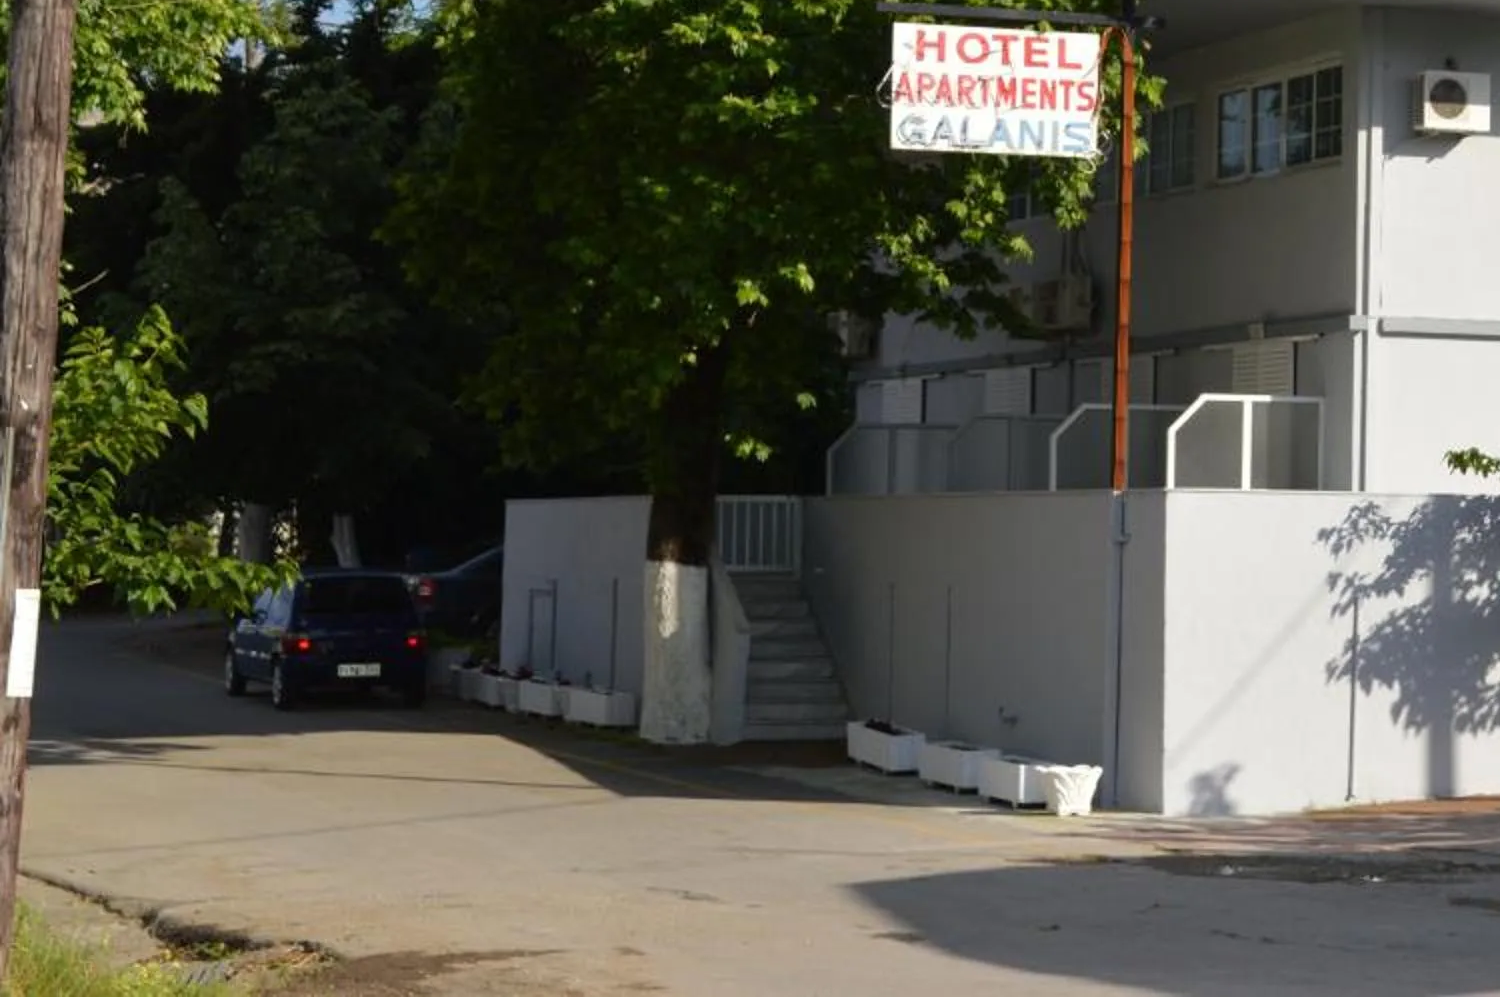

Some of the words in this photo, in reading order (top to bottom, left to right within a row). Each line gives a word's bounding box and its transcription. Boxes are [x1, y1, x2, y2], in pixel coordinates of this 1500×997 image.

[914, 29, 1083, 71] HOTEL
[894, 71, 1096, 112] APARTMENTS
[897, 113, 1092, 153] GALANIS
